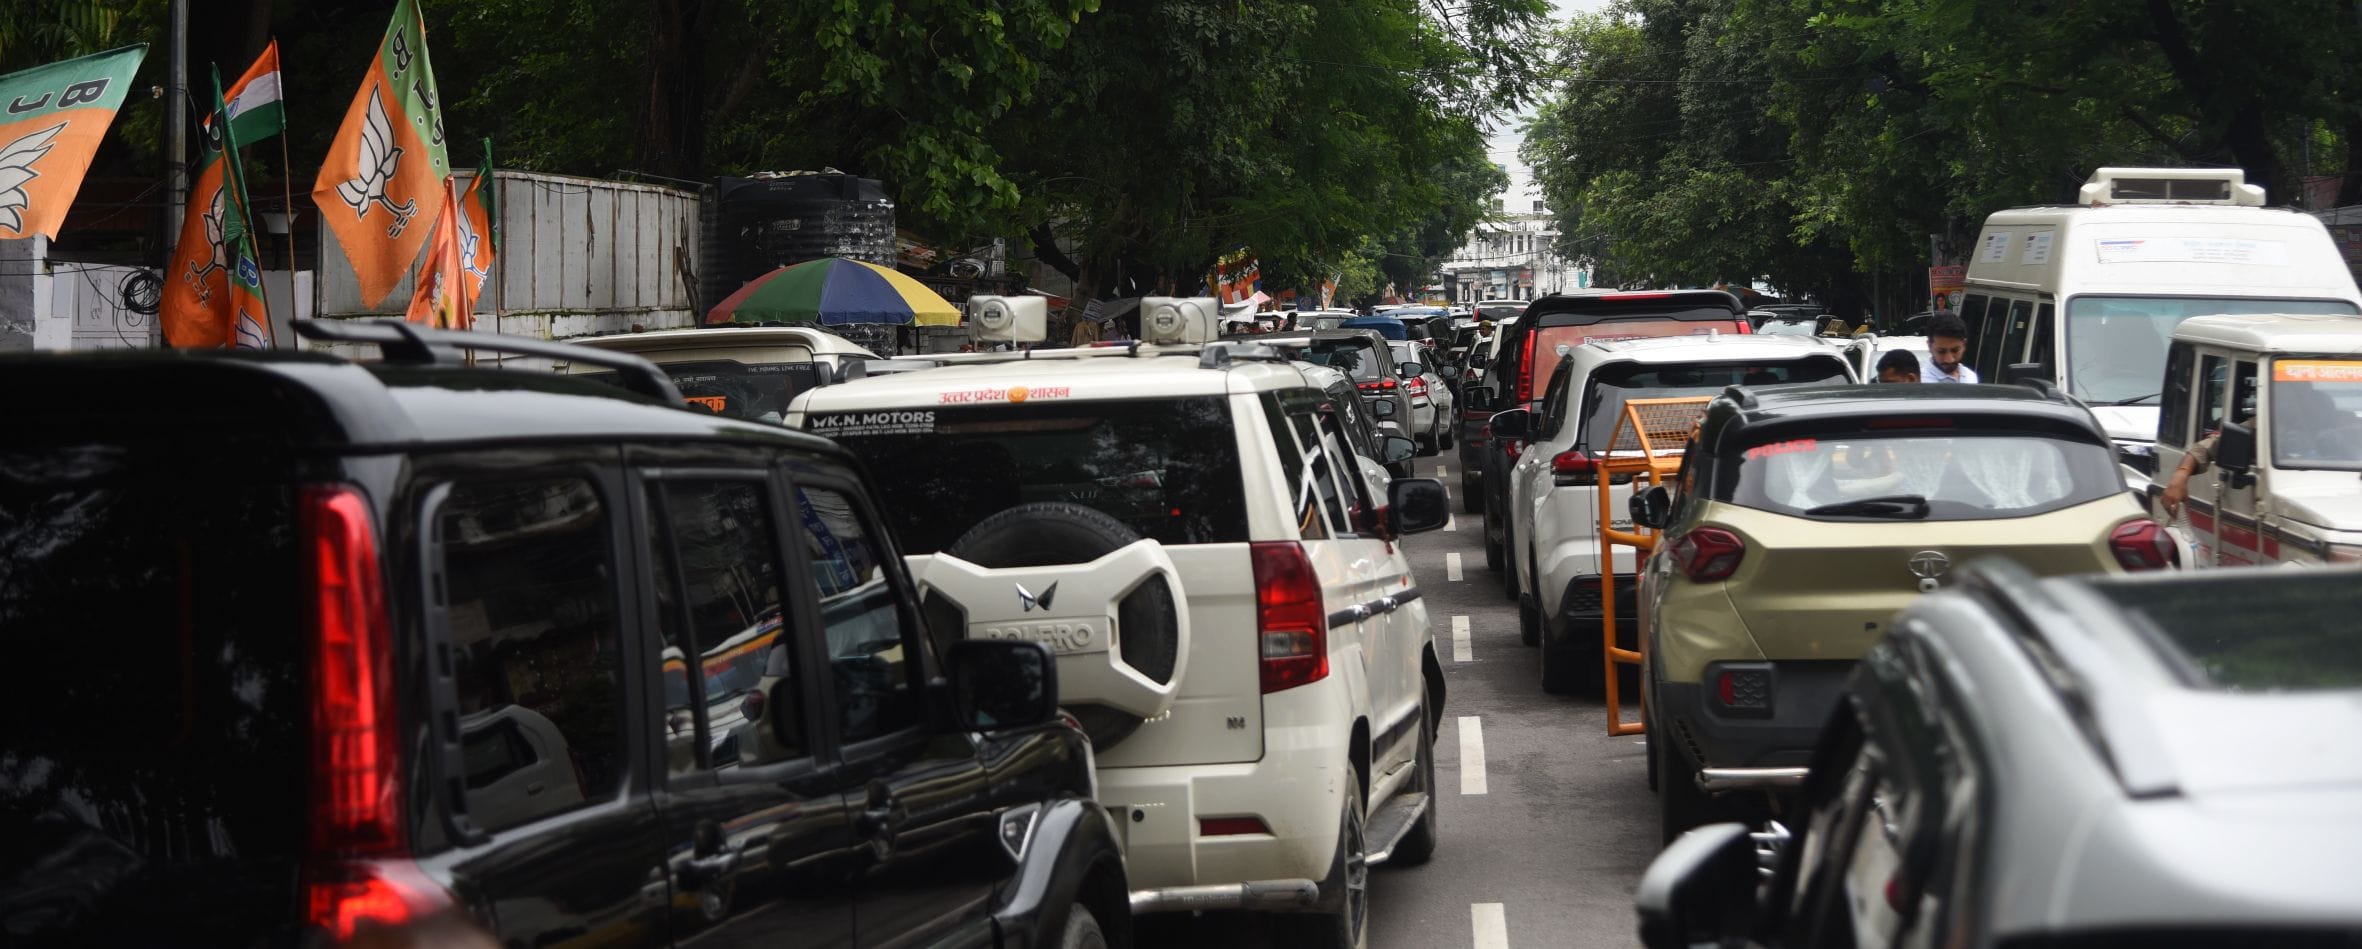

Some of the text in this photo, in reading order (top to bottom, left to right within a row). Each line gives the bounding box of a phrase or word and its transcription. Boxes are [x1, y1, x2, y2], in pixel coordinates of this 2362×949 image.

[940, 386, 1071, 403] उत्तर प्रदेश शासन
[827, 411, 936, 427] K.N. MOTORS
[1747, 439, 1817, 460] POLICE
